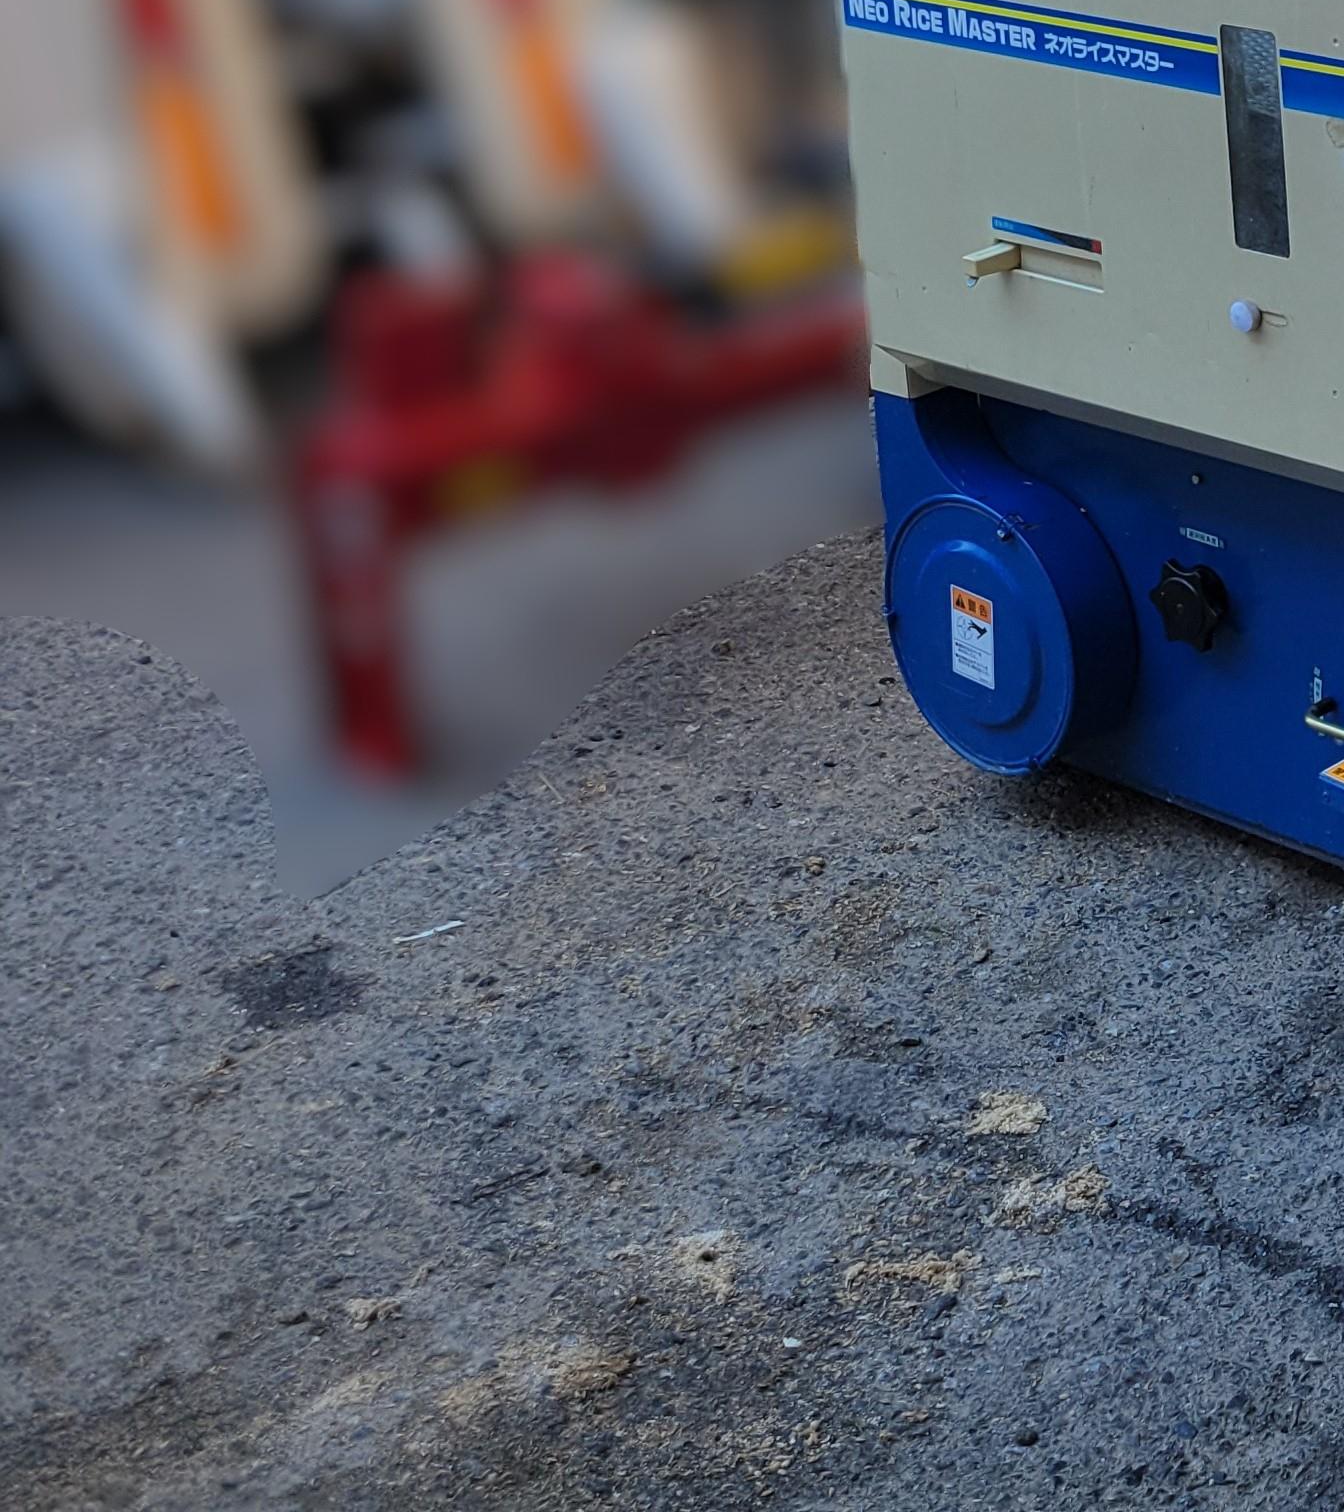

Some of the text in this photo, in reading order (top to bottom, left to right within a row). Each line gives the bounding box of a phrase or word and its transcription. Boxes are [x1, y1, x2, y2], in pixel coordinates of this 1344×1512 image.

[947, 7, 1037, 51] MASTER
[1043, 32, 1175, 72] ネオライスマスター
